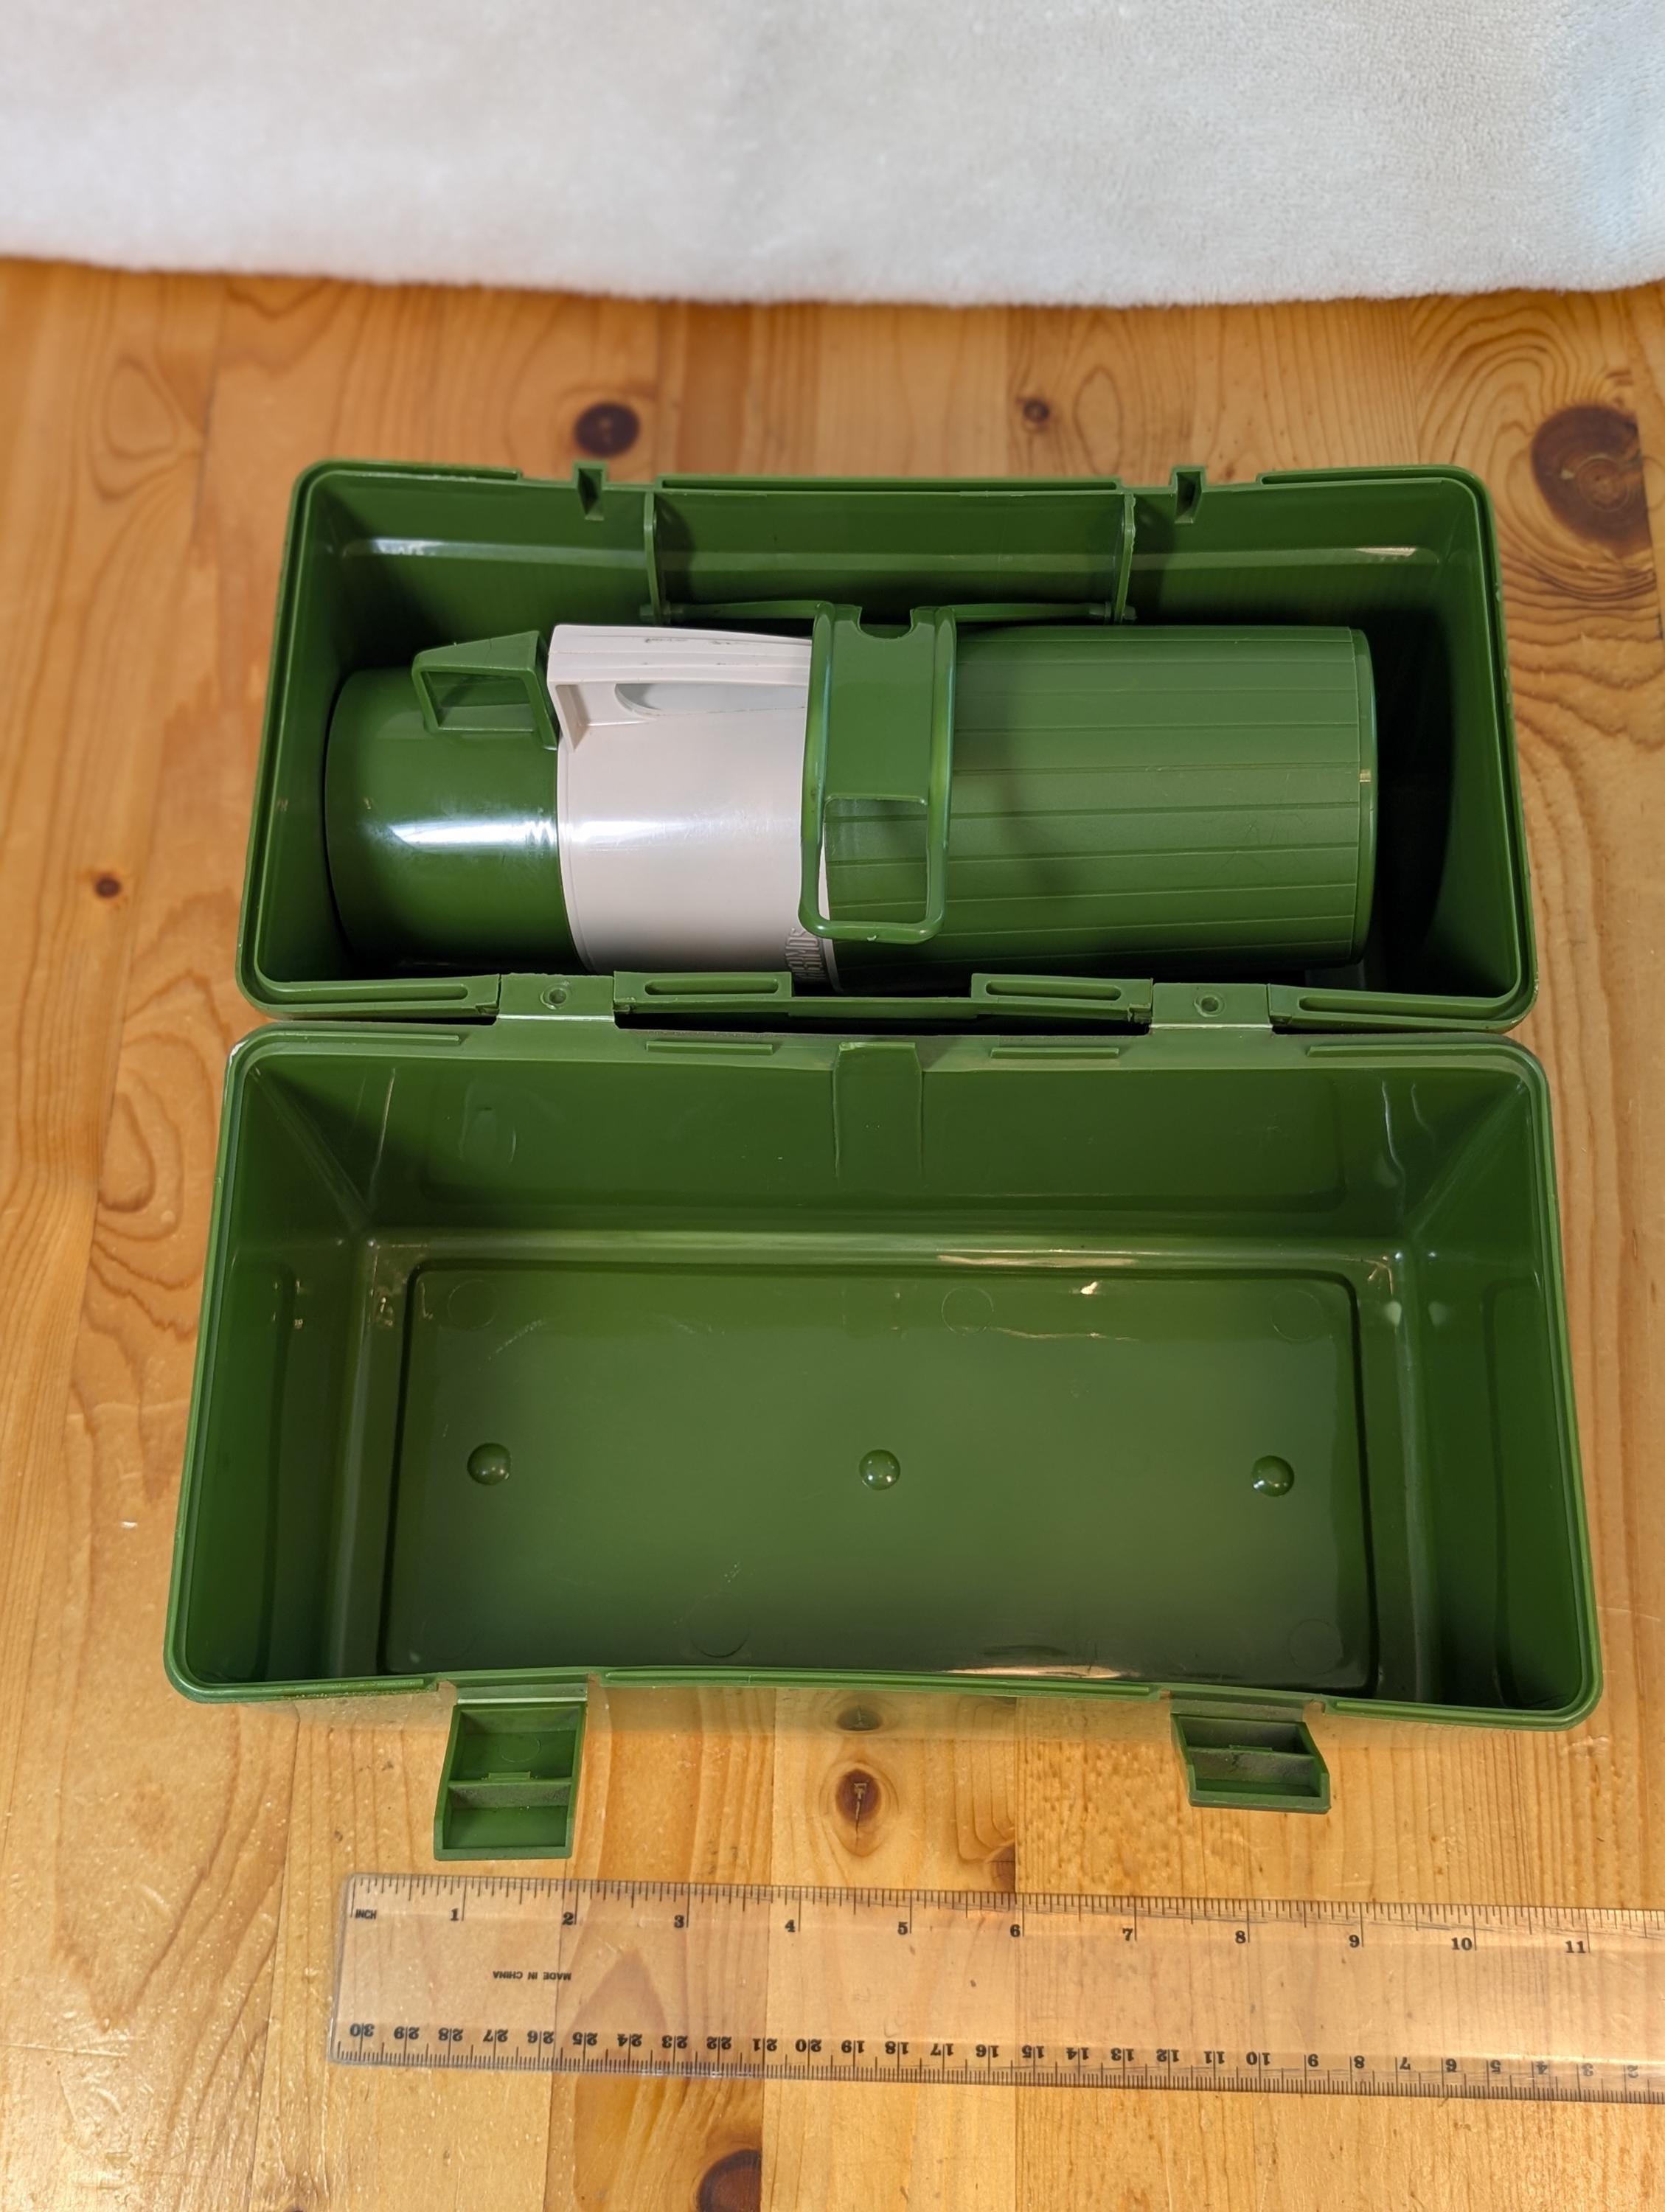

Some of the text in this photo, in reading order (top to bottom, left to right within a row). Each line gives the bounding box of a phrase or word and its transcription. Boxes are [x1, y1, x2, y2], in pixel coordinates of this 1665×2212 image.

[355, 1908, 1586, 1953] INCH 1 2 3 4 5 6 7 8 9 10 11
[493, 1970, 571, 1980] MADE IN CHINA
[350, 2023, 1638, 2079] 2 3 4 5 6 7 8 9 10 11 12 13 14 15 16 17 18 19 20 21 22 23 24 25 26 27 28 29 30
